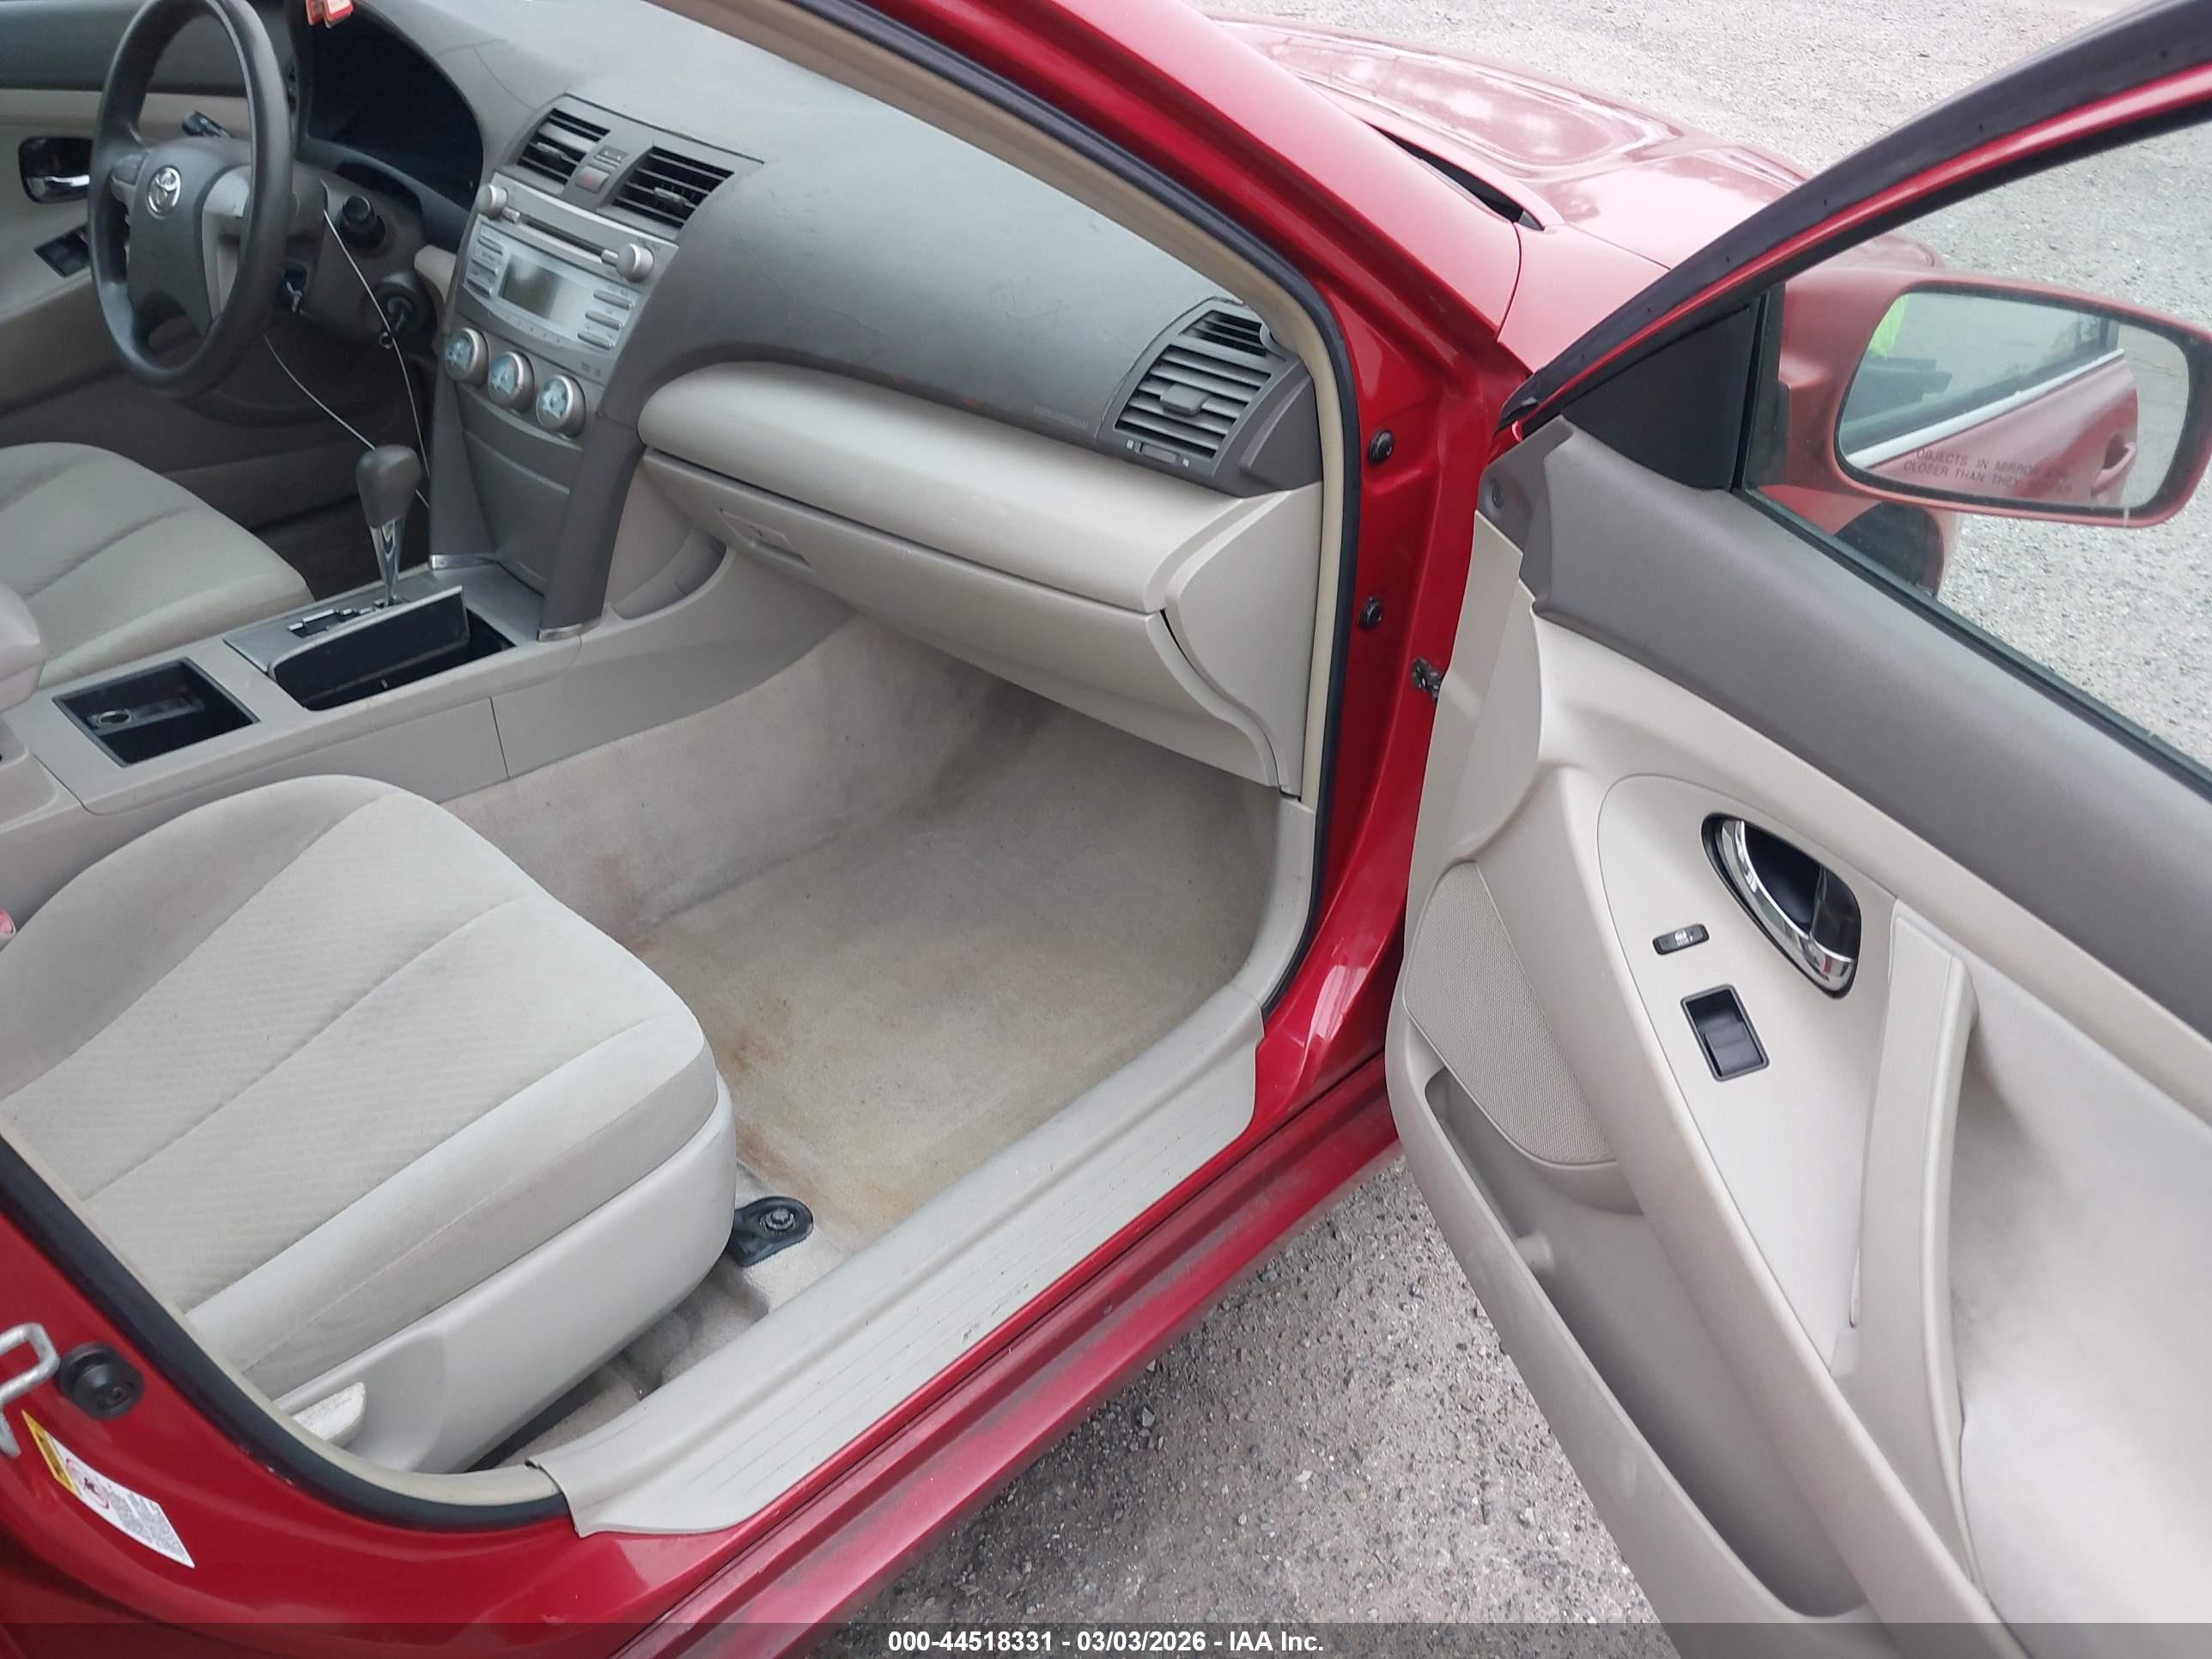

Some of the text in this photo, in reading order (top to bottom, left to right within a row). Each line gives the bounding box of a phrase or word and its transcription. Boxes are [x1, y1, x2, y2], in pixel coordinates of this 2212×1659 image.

[1916, 447, 1969, 465] OBJECTS
[1977, 458, 1989, 470] IN
[1904, 460, 1949, 477] CLOSER
[1955, 467, 1985, 483] THAN
